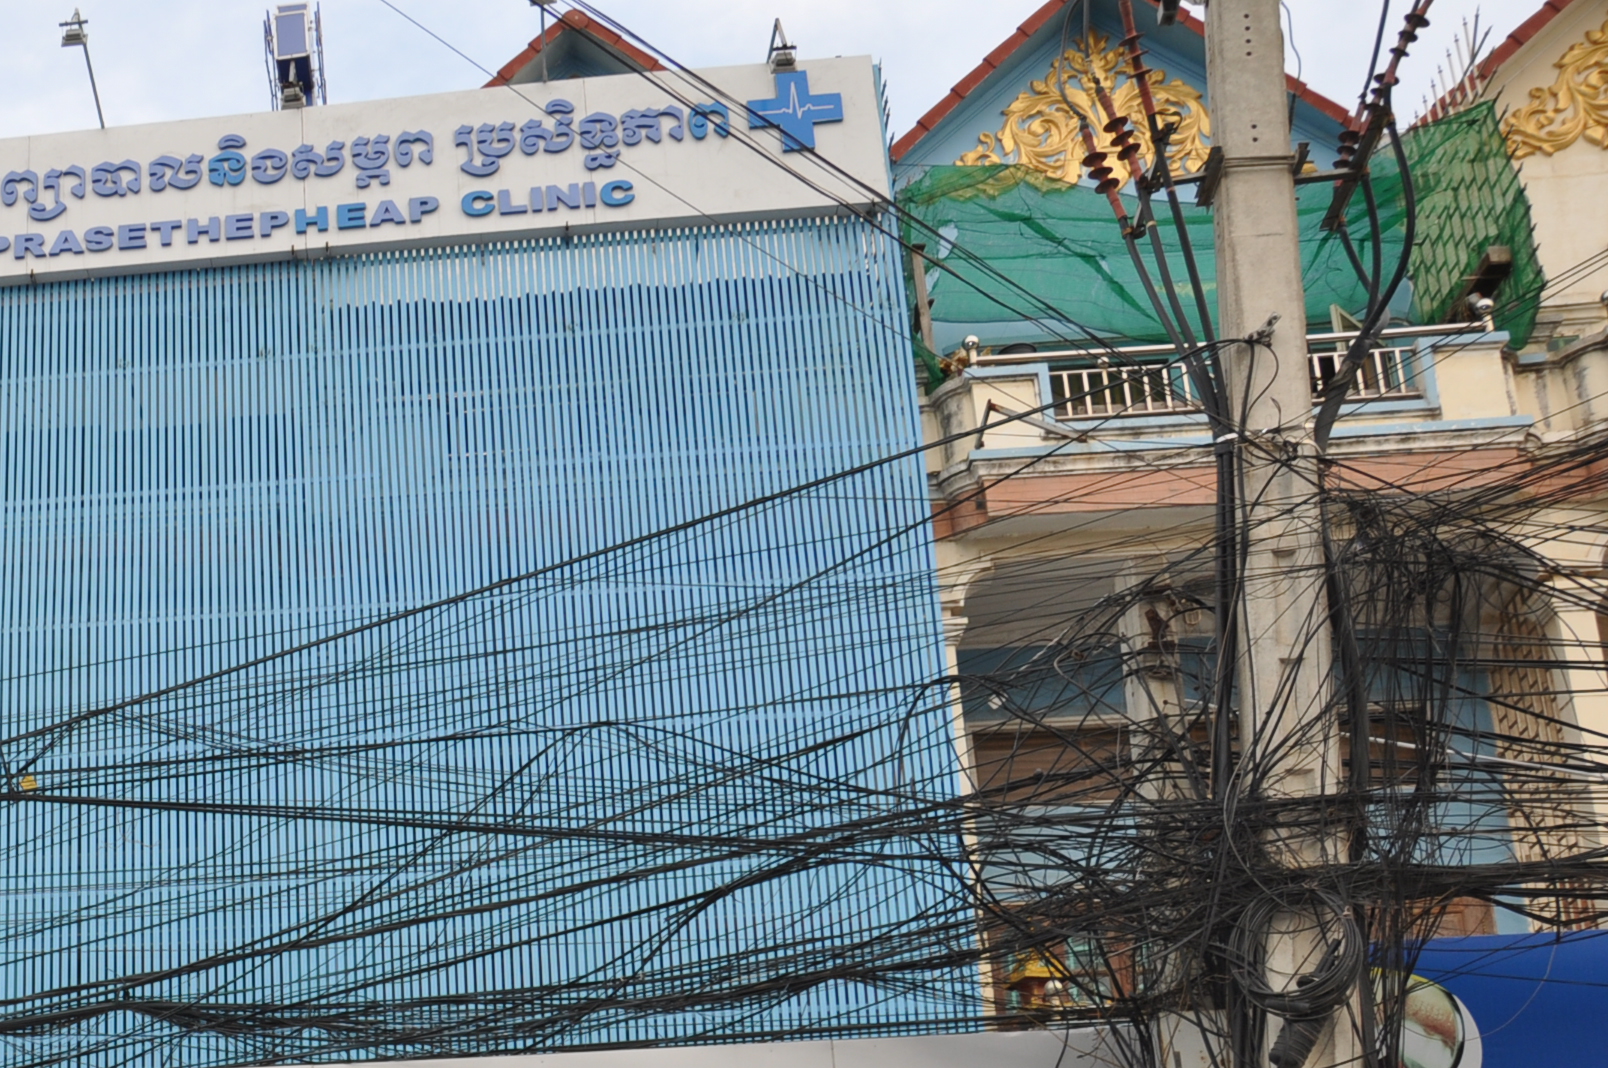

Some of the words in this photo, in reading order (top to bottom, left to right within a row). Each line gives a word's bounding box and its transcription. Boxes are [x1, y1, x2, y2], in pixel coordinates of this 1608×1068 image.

[454, 98, 730, 177] ប្រសិទ្ធភាព
[461, 179, 636, 217] CLINIC
